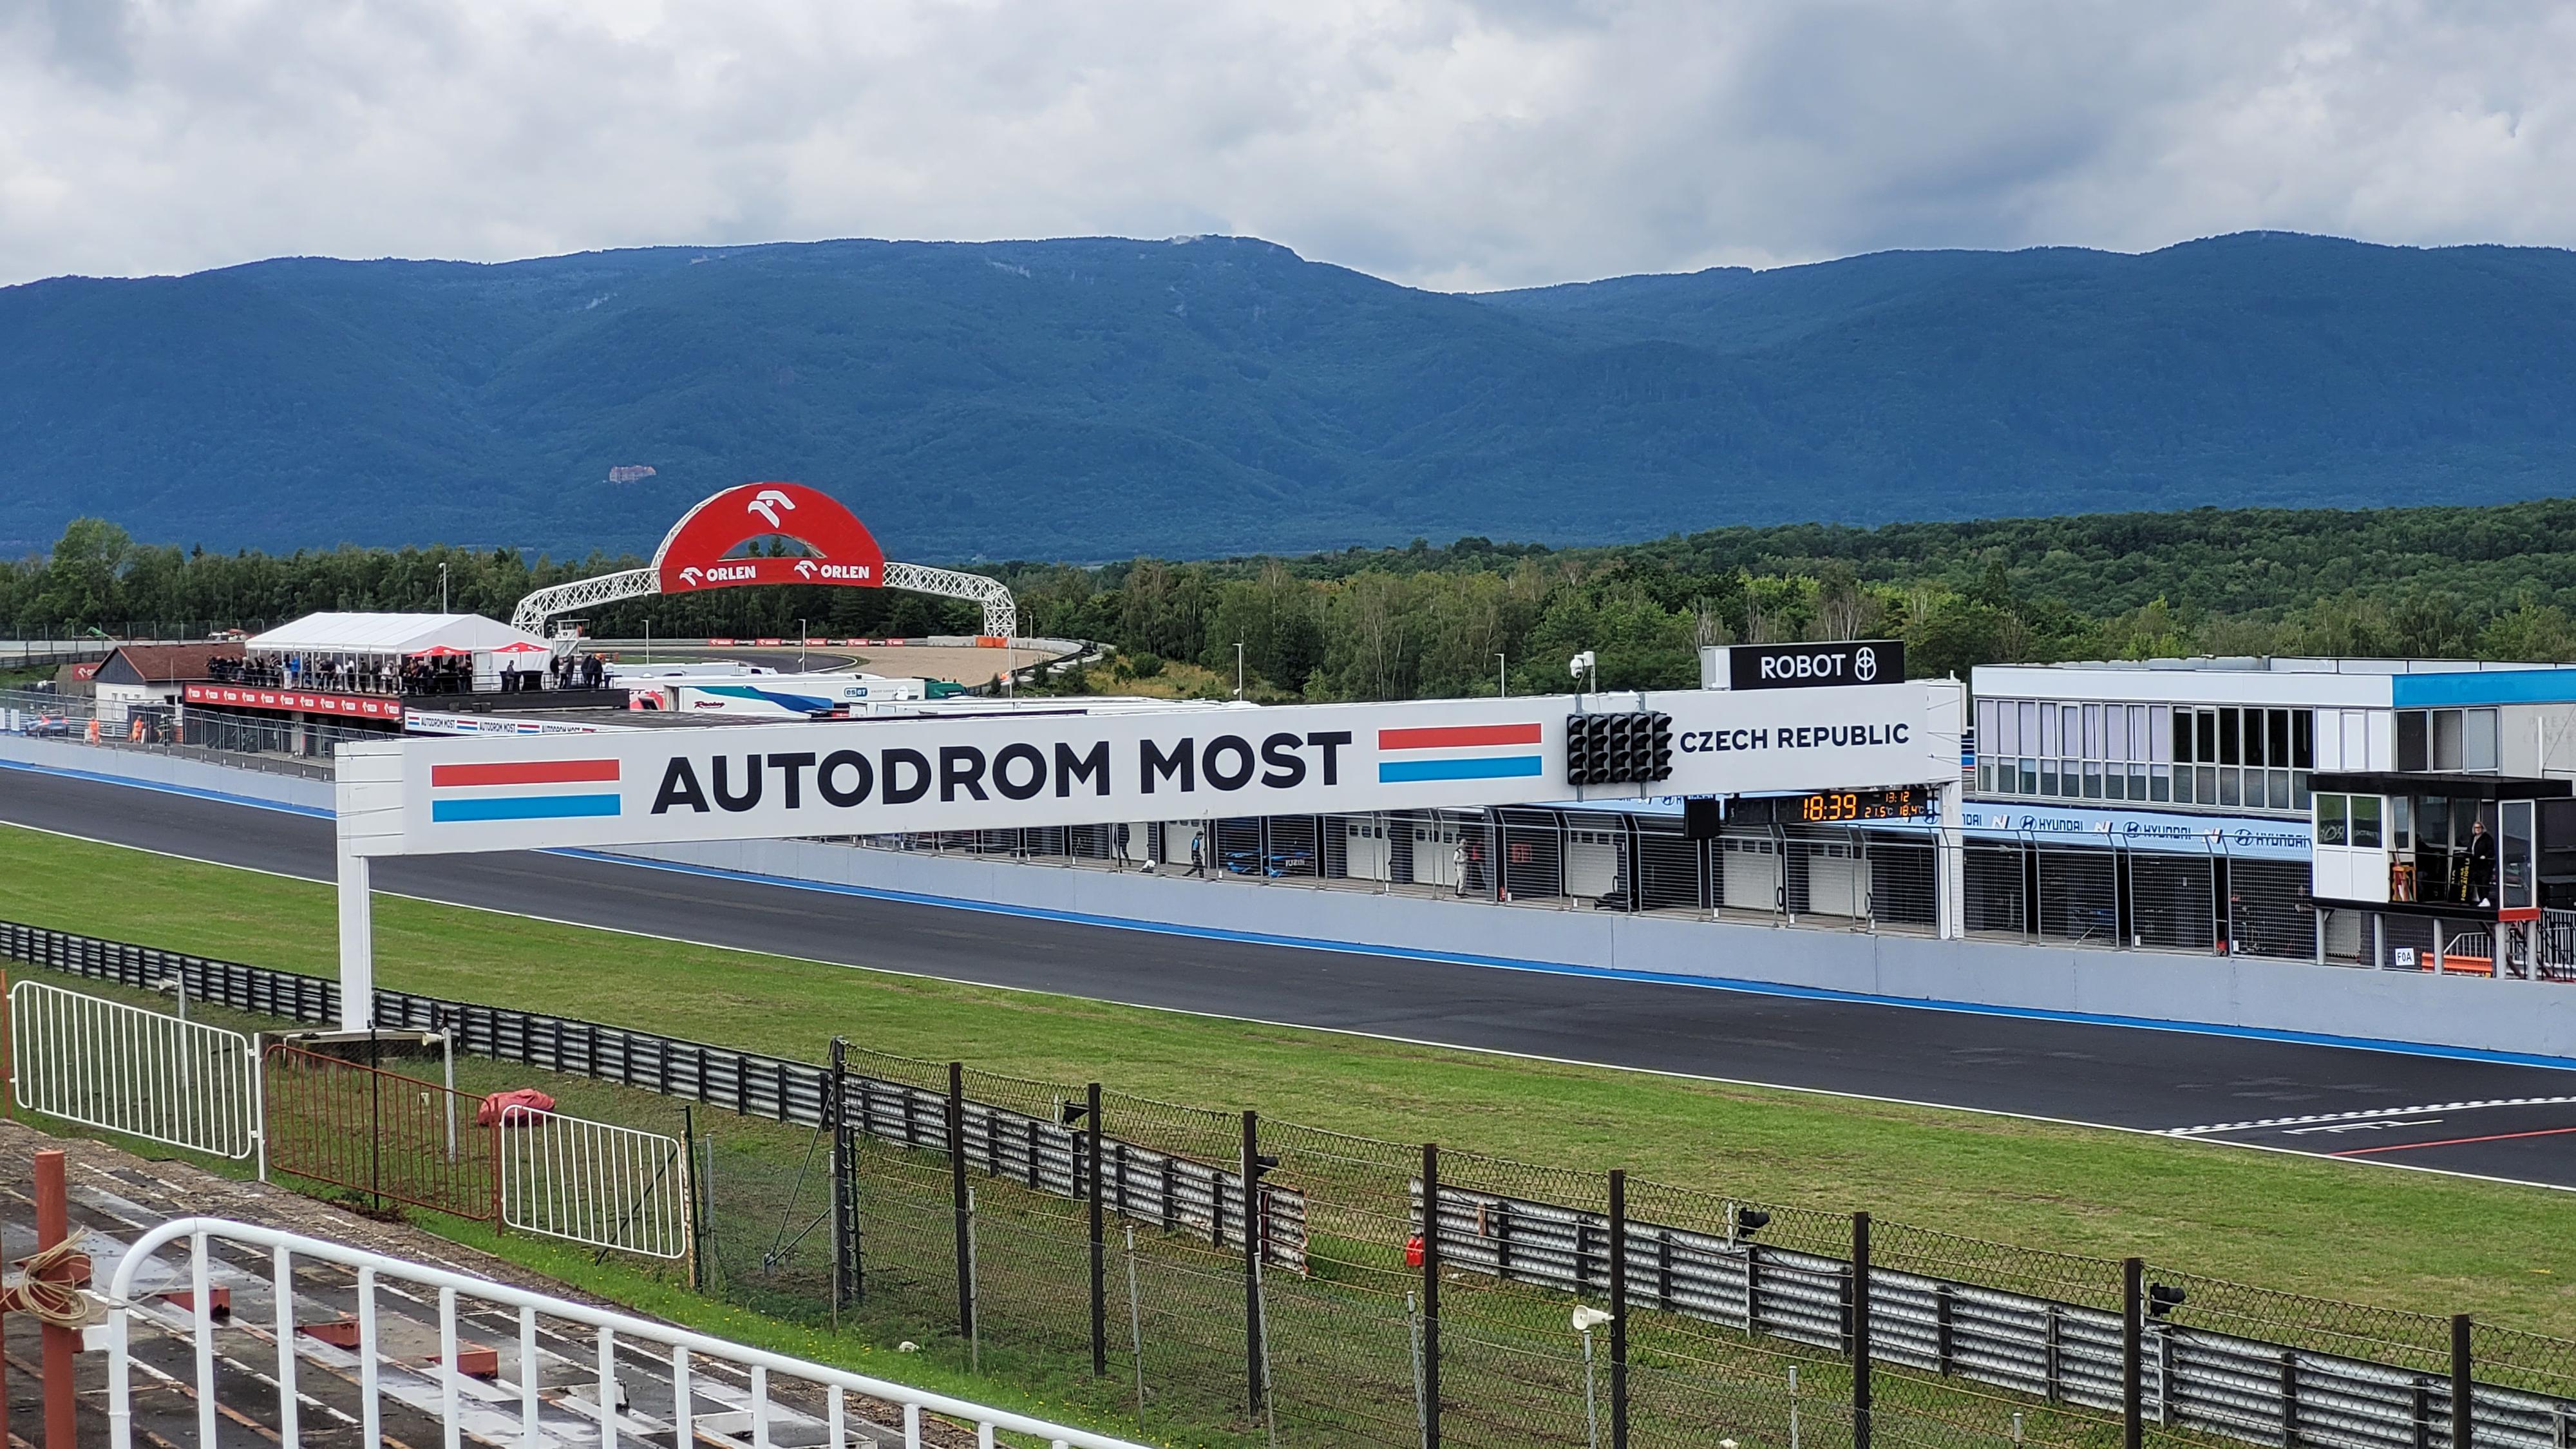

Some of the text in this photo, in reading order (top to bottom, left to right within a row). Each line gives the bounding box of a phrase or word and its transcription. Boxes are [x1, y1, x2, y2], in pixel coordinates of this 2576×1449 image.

[706, 565, 756, 582] ORLEN
[820, 565, 869, 579] ORLEN
[1761, 654, 1846, 679] ROBOT
[421, 717, 455, 728] AUTODROM MOST
[479, 721, 516, 733] AUTODROM MOST
[1680, 723, 1909, 753] CZECH REPUBLIC
[651, 732, 1352, 814] AUTODROM MOST
[1886, 791, 1909, 803] 13:12
[1804, 794, 1856, 820] 18:39
[2039, 818, 2083, 831] HYUNDAI
[2144, 824, 2191, 840] HYUNDAI
[2256, 832, 2306, 848] HYUNDAI
[2397, 952, 2412, 961] FOA
